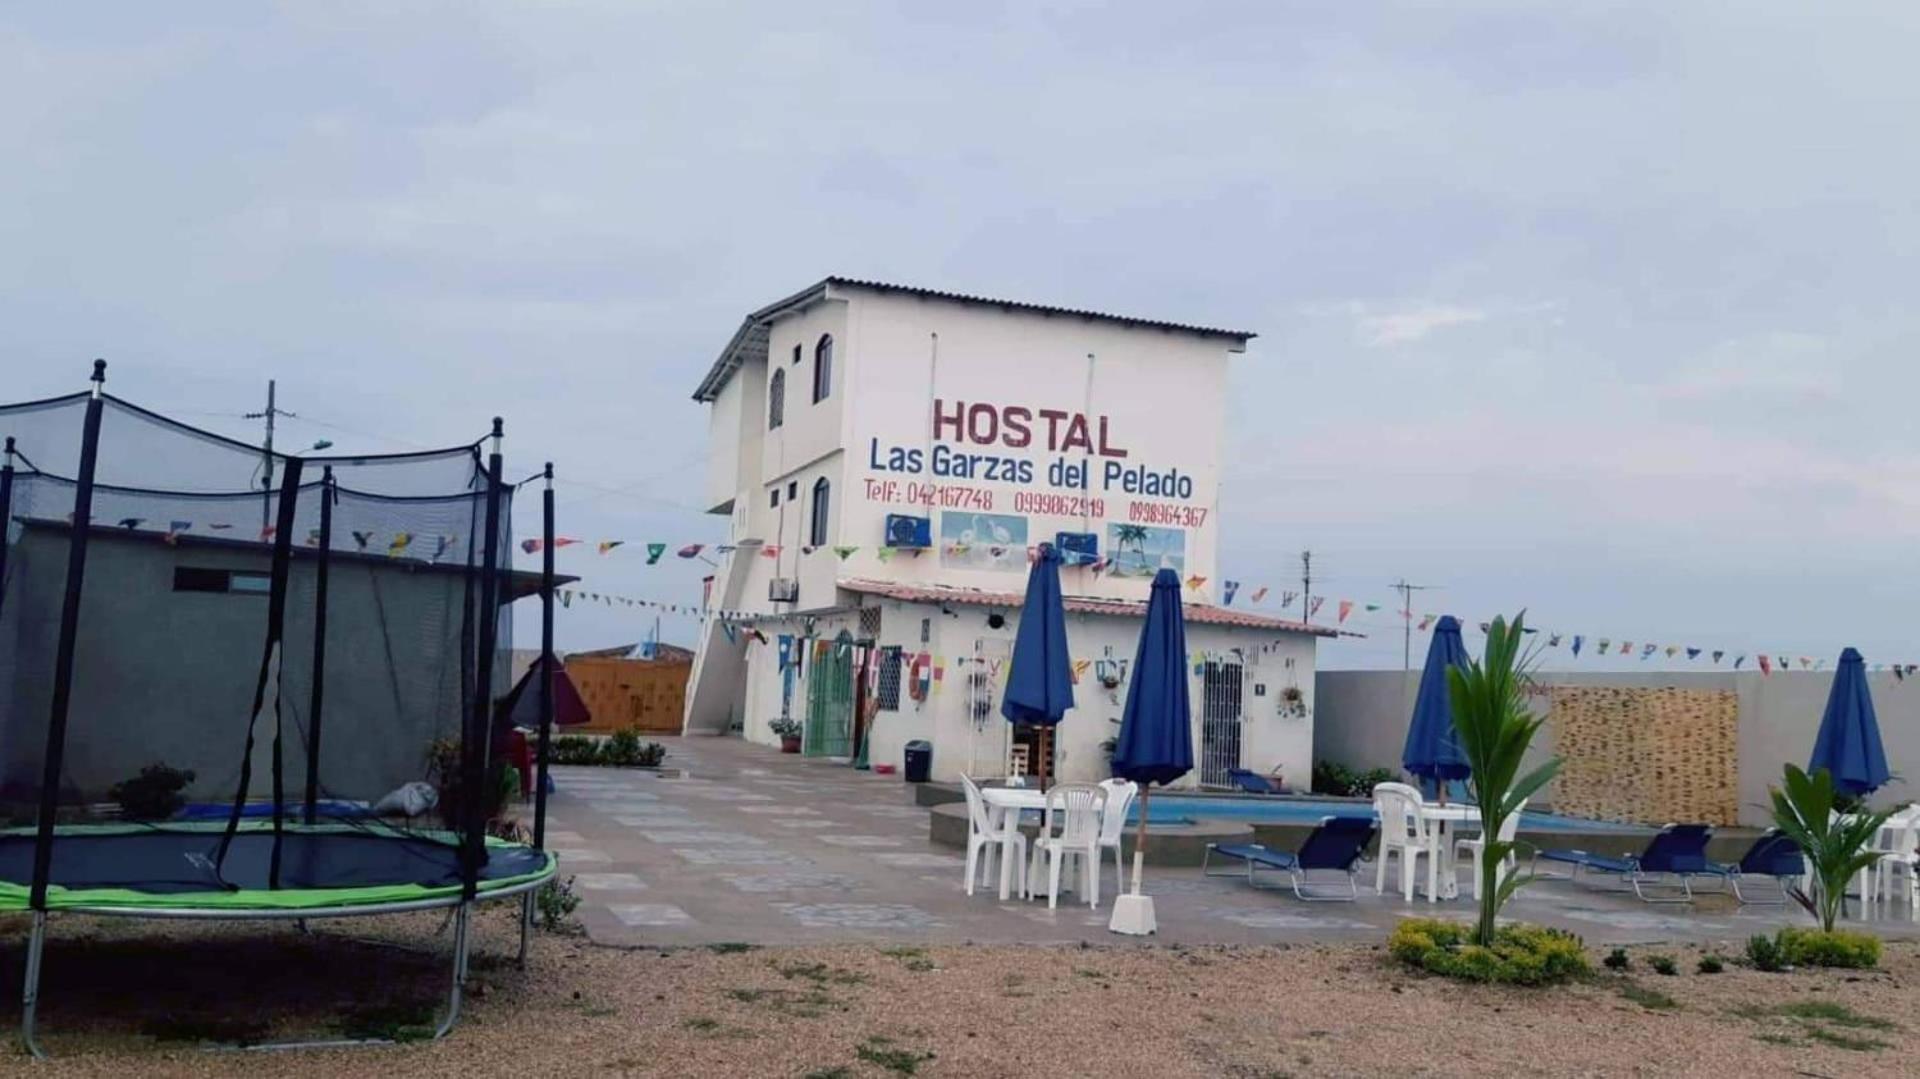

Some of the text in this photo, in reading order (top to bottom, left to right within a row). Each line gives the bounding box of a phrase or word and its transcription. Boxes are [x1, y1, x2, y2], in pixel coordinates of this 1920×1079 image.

[933, 398, 1128, 458] HOSTAL
[864, 478, 901, 502] Telf:
[907, 481, 993, 511] 042167748
[870, 437, 1192, 499] Las Garzas del Pelado
